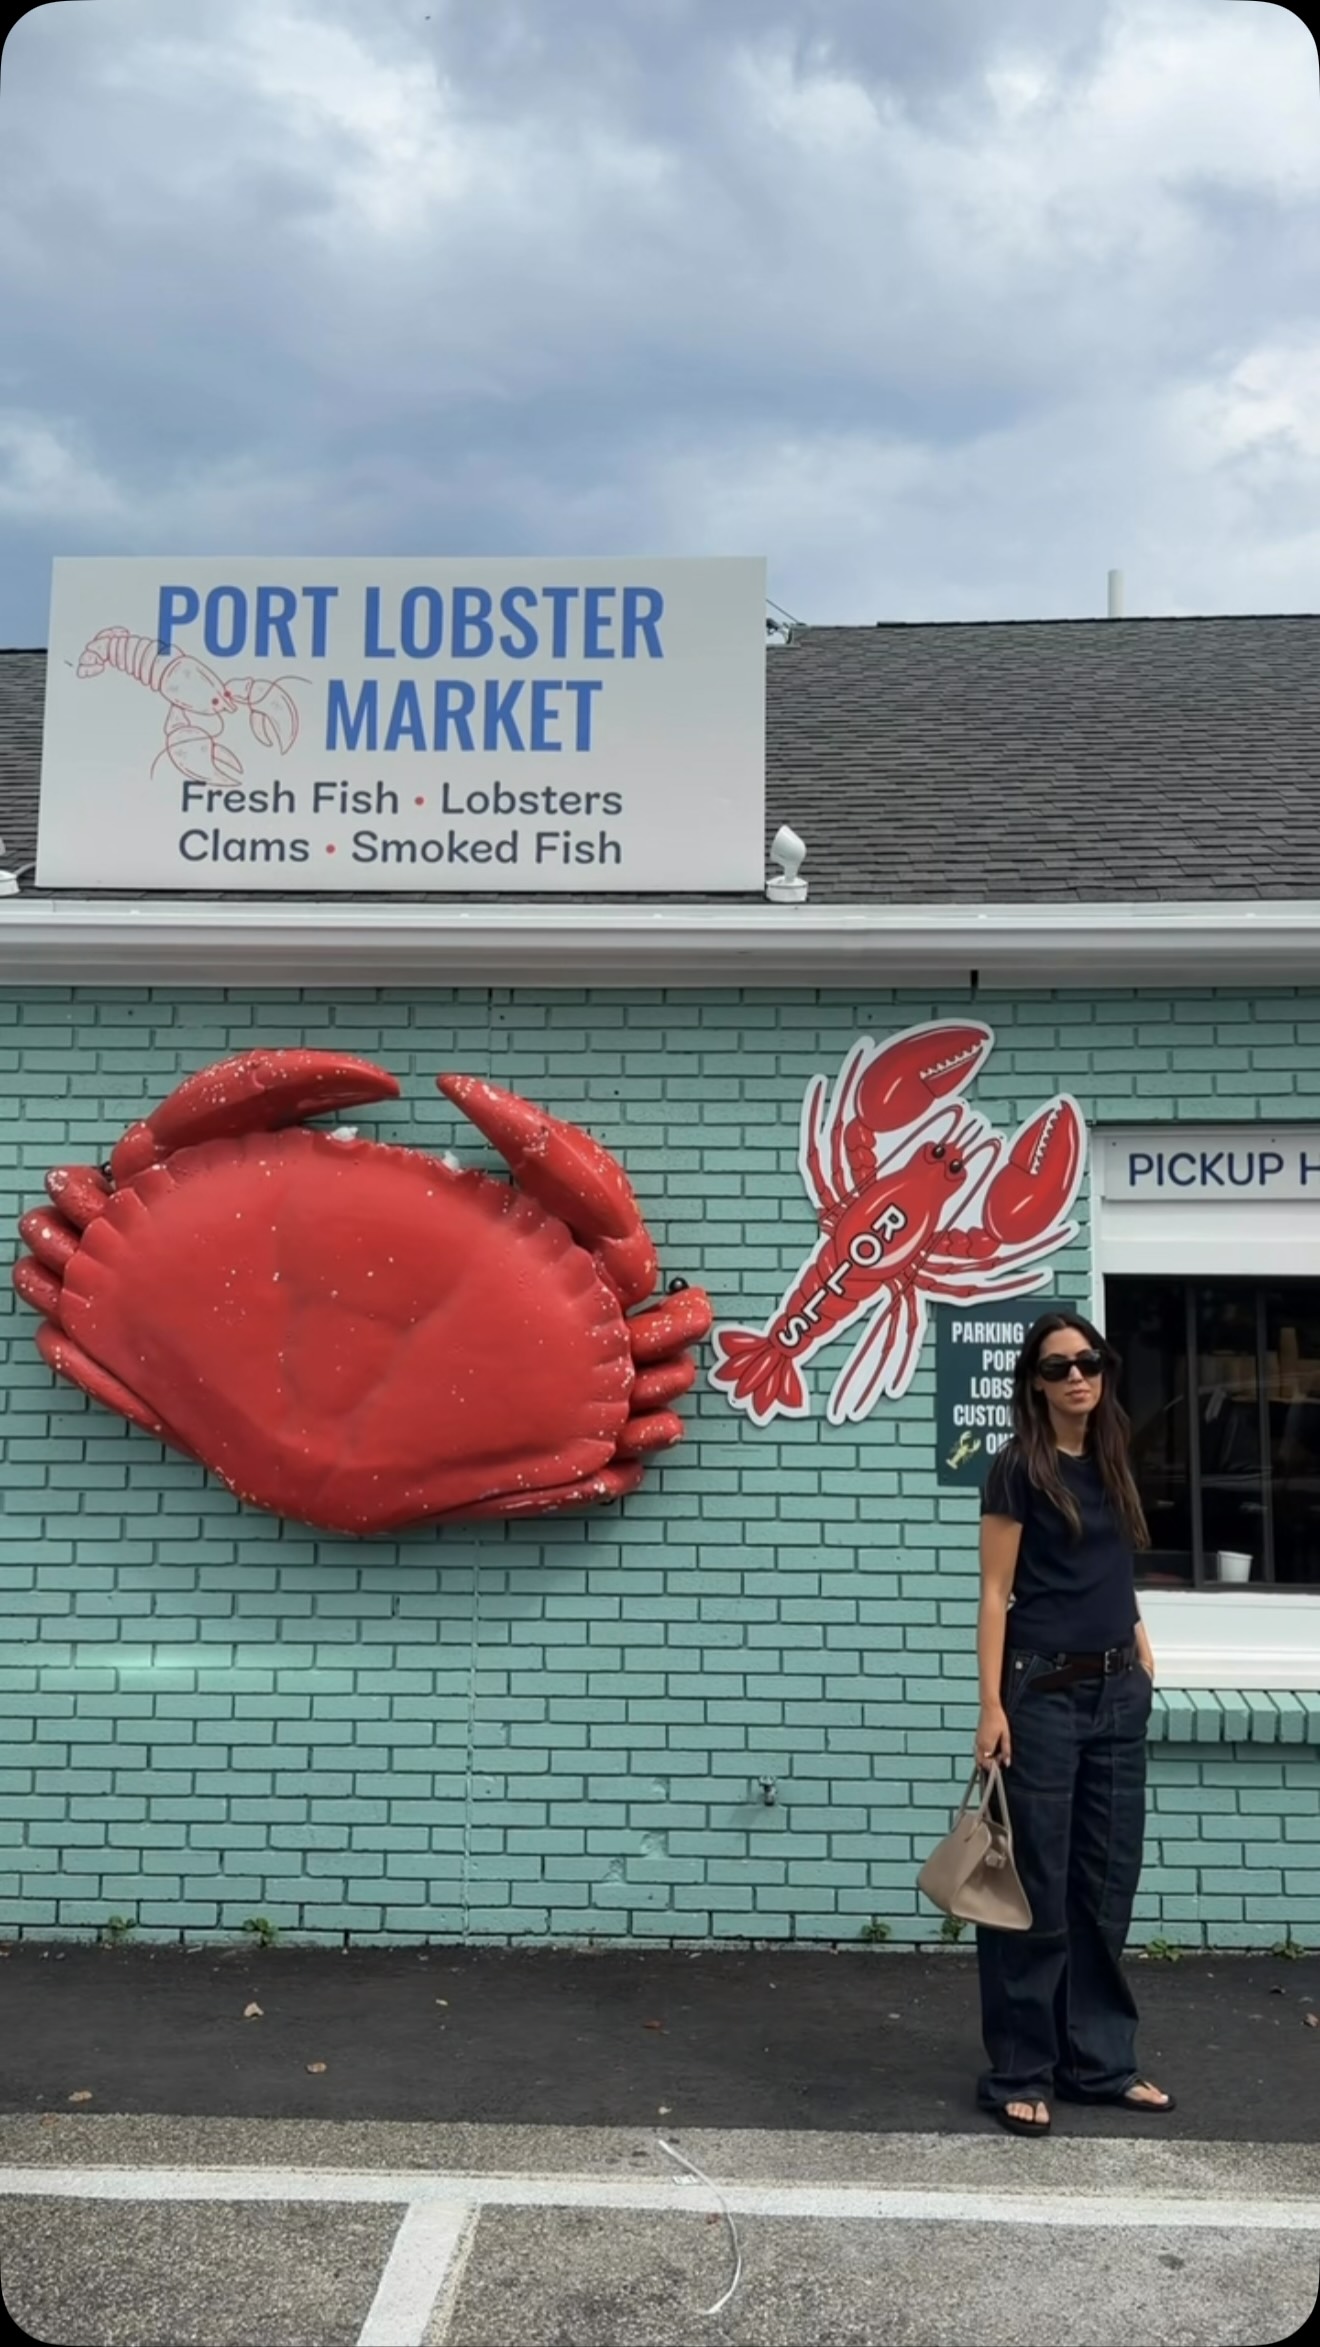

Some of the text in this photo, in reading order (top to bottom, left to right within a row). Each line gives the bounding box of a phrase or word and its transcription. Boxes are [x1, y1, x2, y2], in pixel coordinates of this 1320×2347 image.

[157, 586, 664, 659] PORT LOBSTER
[326, 680, 603, 751] MARKET
[182, 780, 622, 815] Fresh Fish Lobsters
[179, 828, 621, 864] Clams Smoked Fish
[1129, 1152, 1284, 1186] PICKUP
[778, 1203, 907, 1347] ROLLS
[952, 1322, 1024, 1343] PARKING
[971, 1377, 1014, 1398] LOBS
